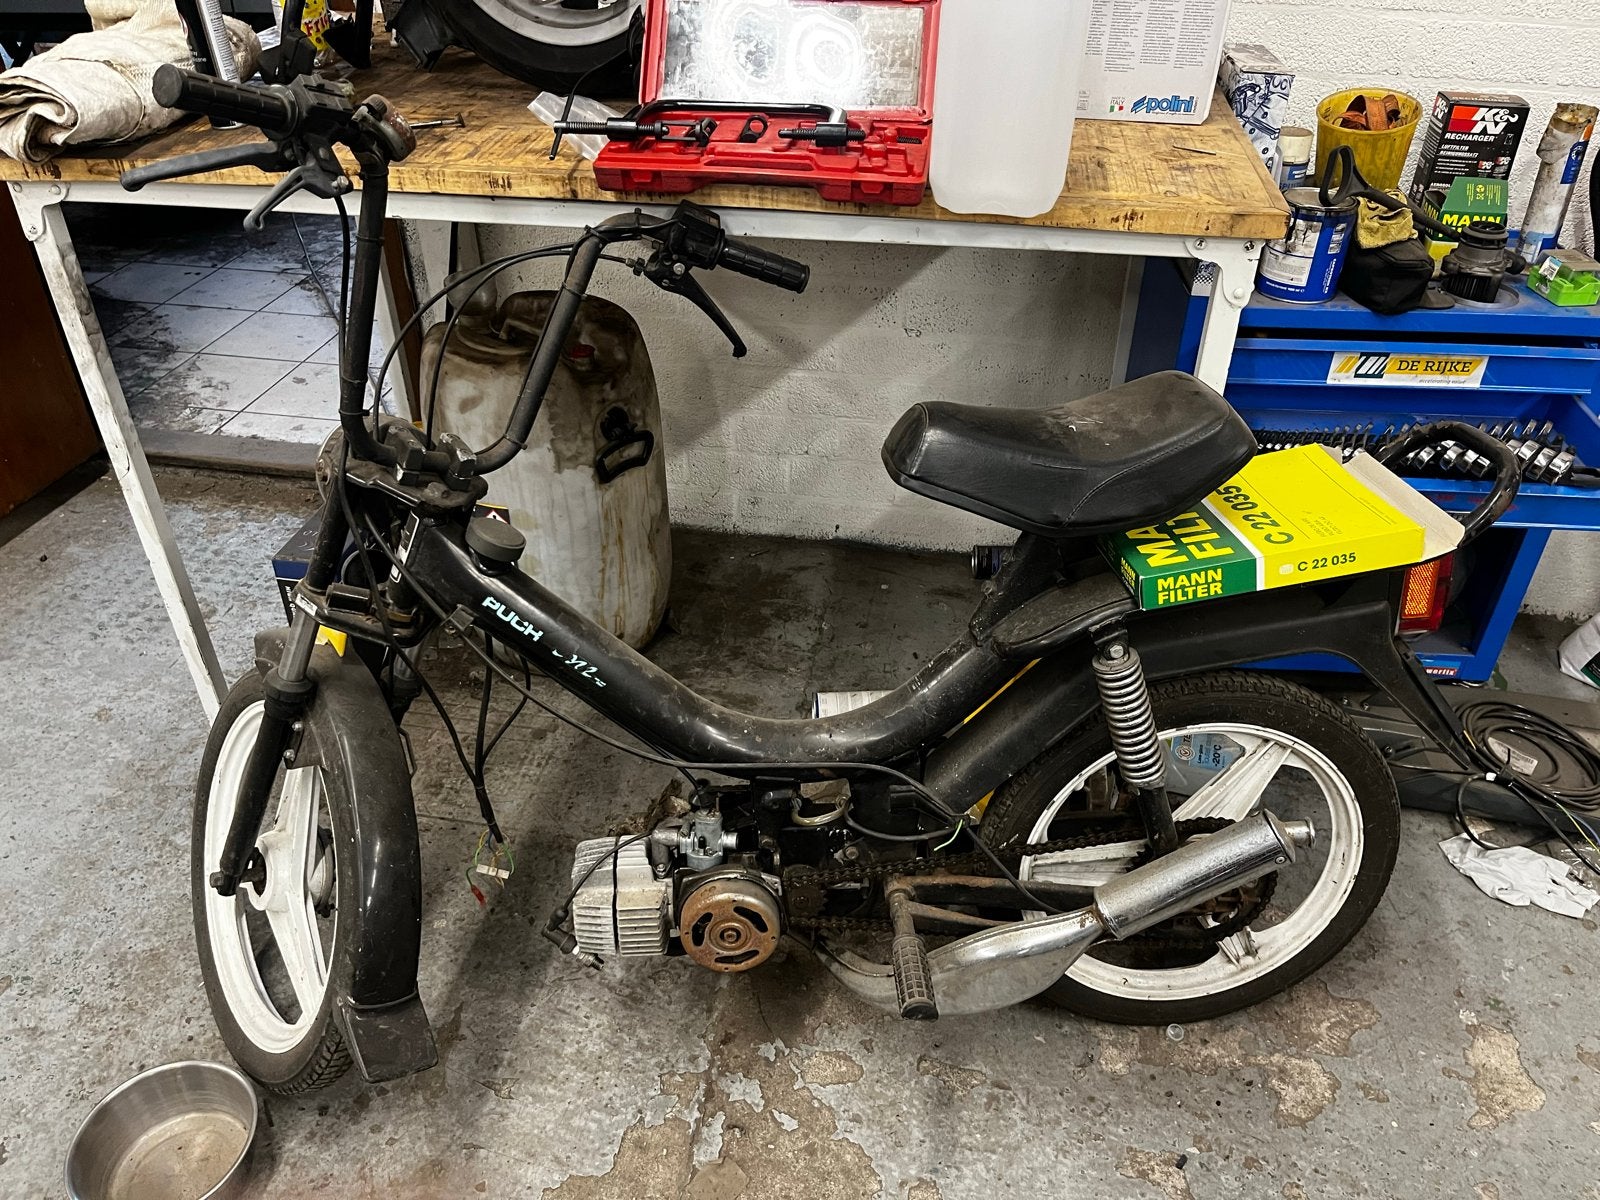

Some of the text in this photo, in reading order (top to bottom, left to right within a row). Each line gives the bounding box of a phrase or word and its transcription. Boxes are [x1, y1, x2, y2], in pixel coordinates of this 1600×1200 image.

[1146, 95, 1195, 113] polini
[1444, 132, 1495, 143] RECHARGER
[1396, 360, 1473, 374] DE RIJKE
[1242, 511, 1281, 530] 22
[1125, 523, 1190, 568] MA
[1165, 511, 1235, 560] FILT
[1263, 531, 1294, 545] C
[1297, 552, 1357, 572] C 22 035
[1157, 568, 1222, 592] MANN
[1157, 582, 1223, 605] FILTER
[481, 596, 544, 642] PUCH
